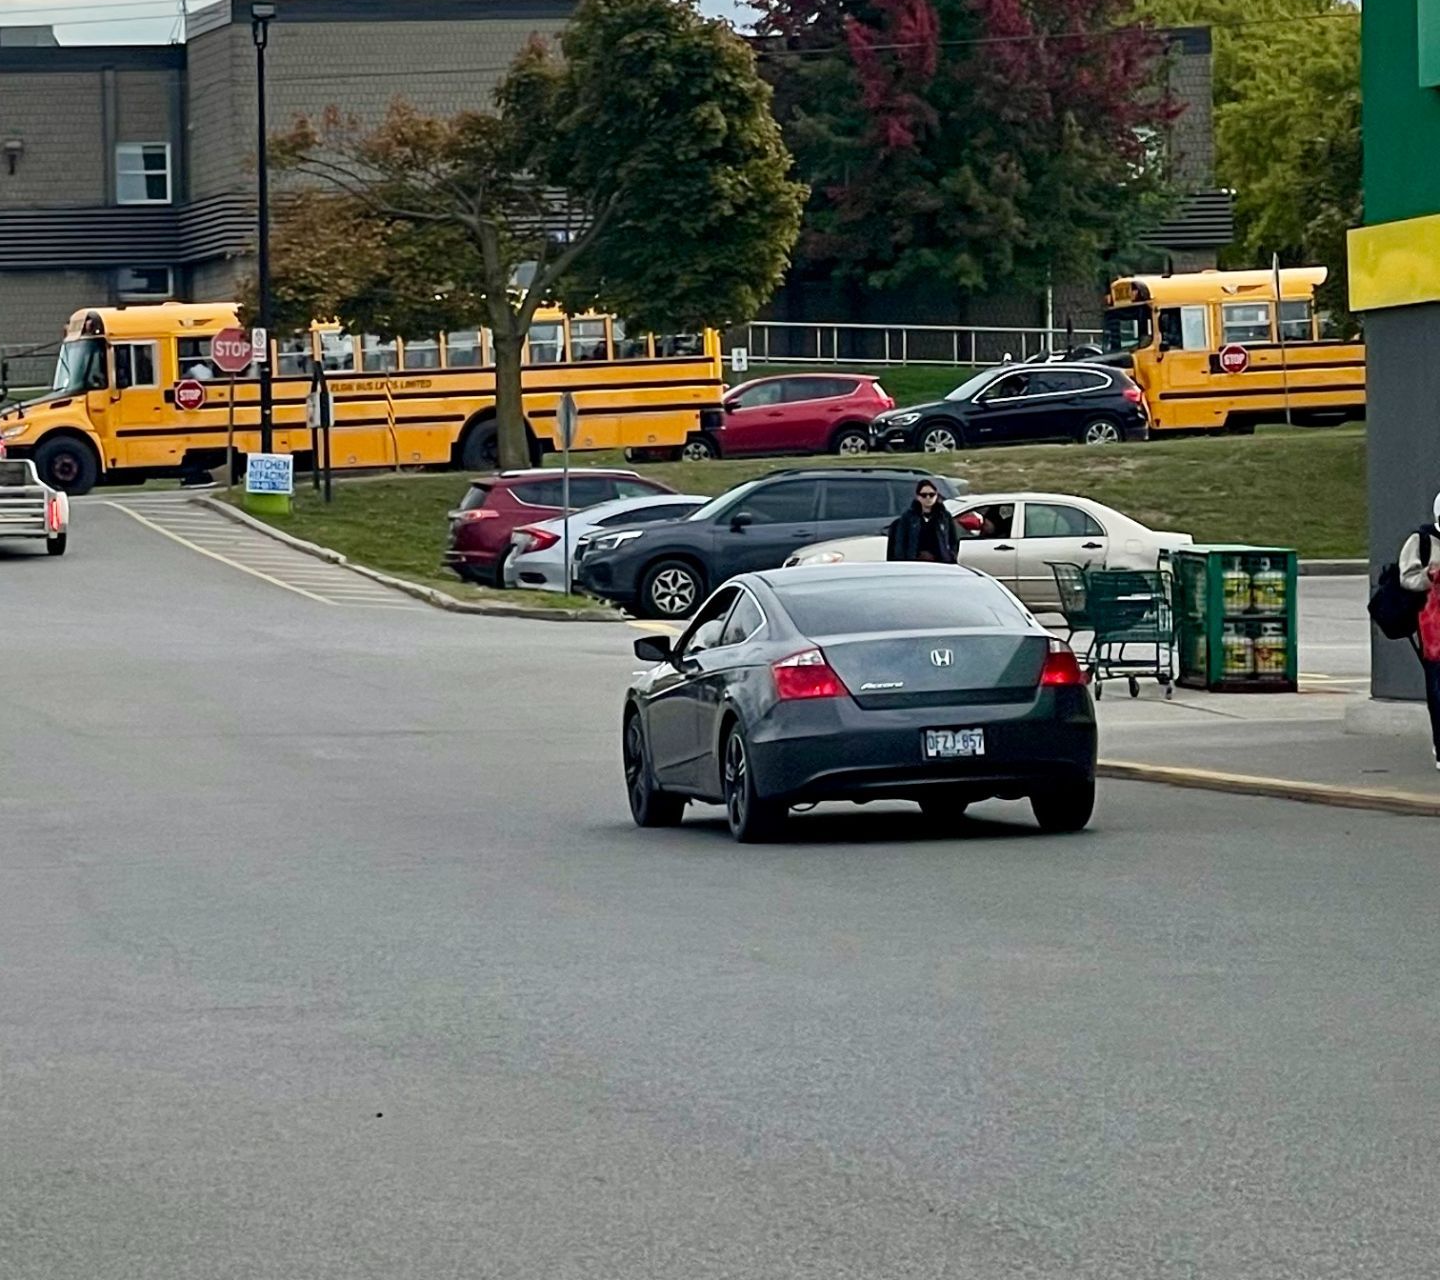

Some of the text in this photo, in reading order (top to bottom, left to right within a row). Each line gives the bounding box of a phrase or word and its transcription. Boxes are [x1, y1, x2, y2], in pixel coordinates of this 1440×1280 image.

[215, 341, 251, 357] STOP
[1224, 353, 1245, 365] STOP
[356, 381, 373, 391] BUS
[400, 379, 432, 389] LIMITED
[179, 389, 201, 401] STOP
[250, 459, 290, 470] KITCHEN
[249, 470, 290, 480] REFACING
[860, 681, 904, 691] Accord
